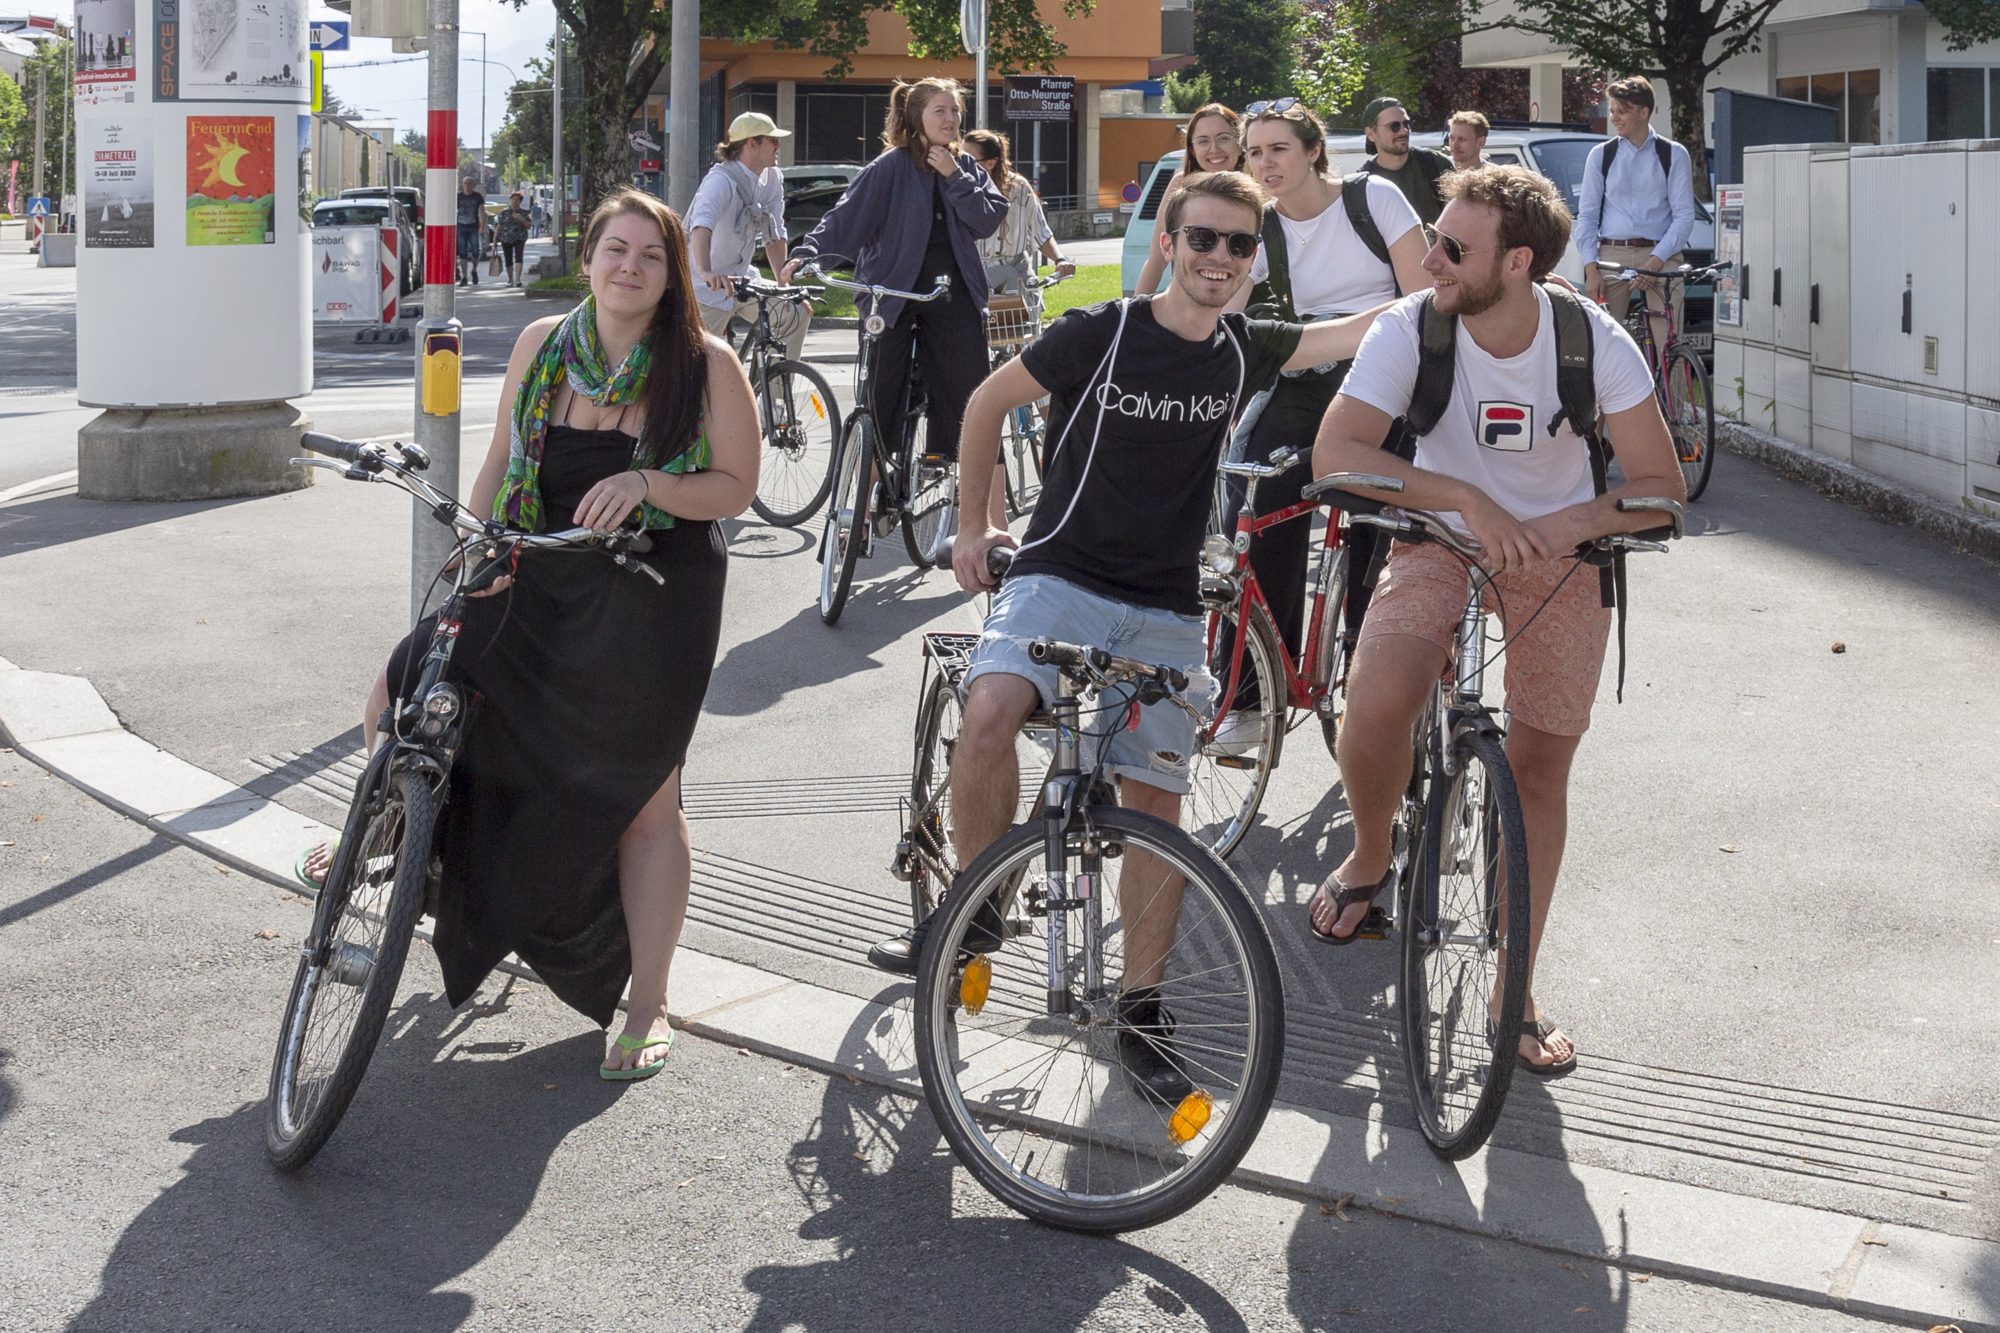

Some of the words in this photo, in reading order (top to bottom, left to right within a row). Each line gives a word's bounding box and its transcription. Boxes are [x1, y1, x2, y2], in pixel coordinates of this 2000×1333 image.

[161, 23, 175, 96] SPACE
[1041, 79, 1074, 89] Pfarrer-
[1010, 89, 1074, 99] Otto-Neururer-
[1041, 100, 1071, 110] Straße
[1096, 383, 1185, 422] Calvin
[1189, 392, 1237, 422] Klei
